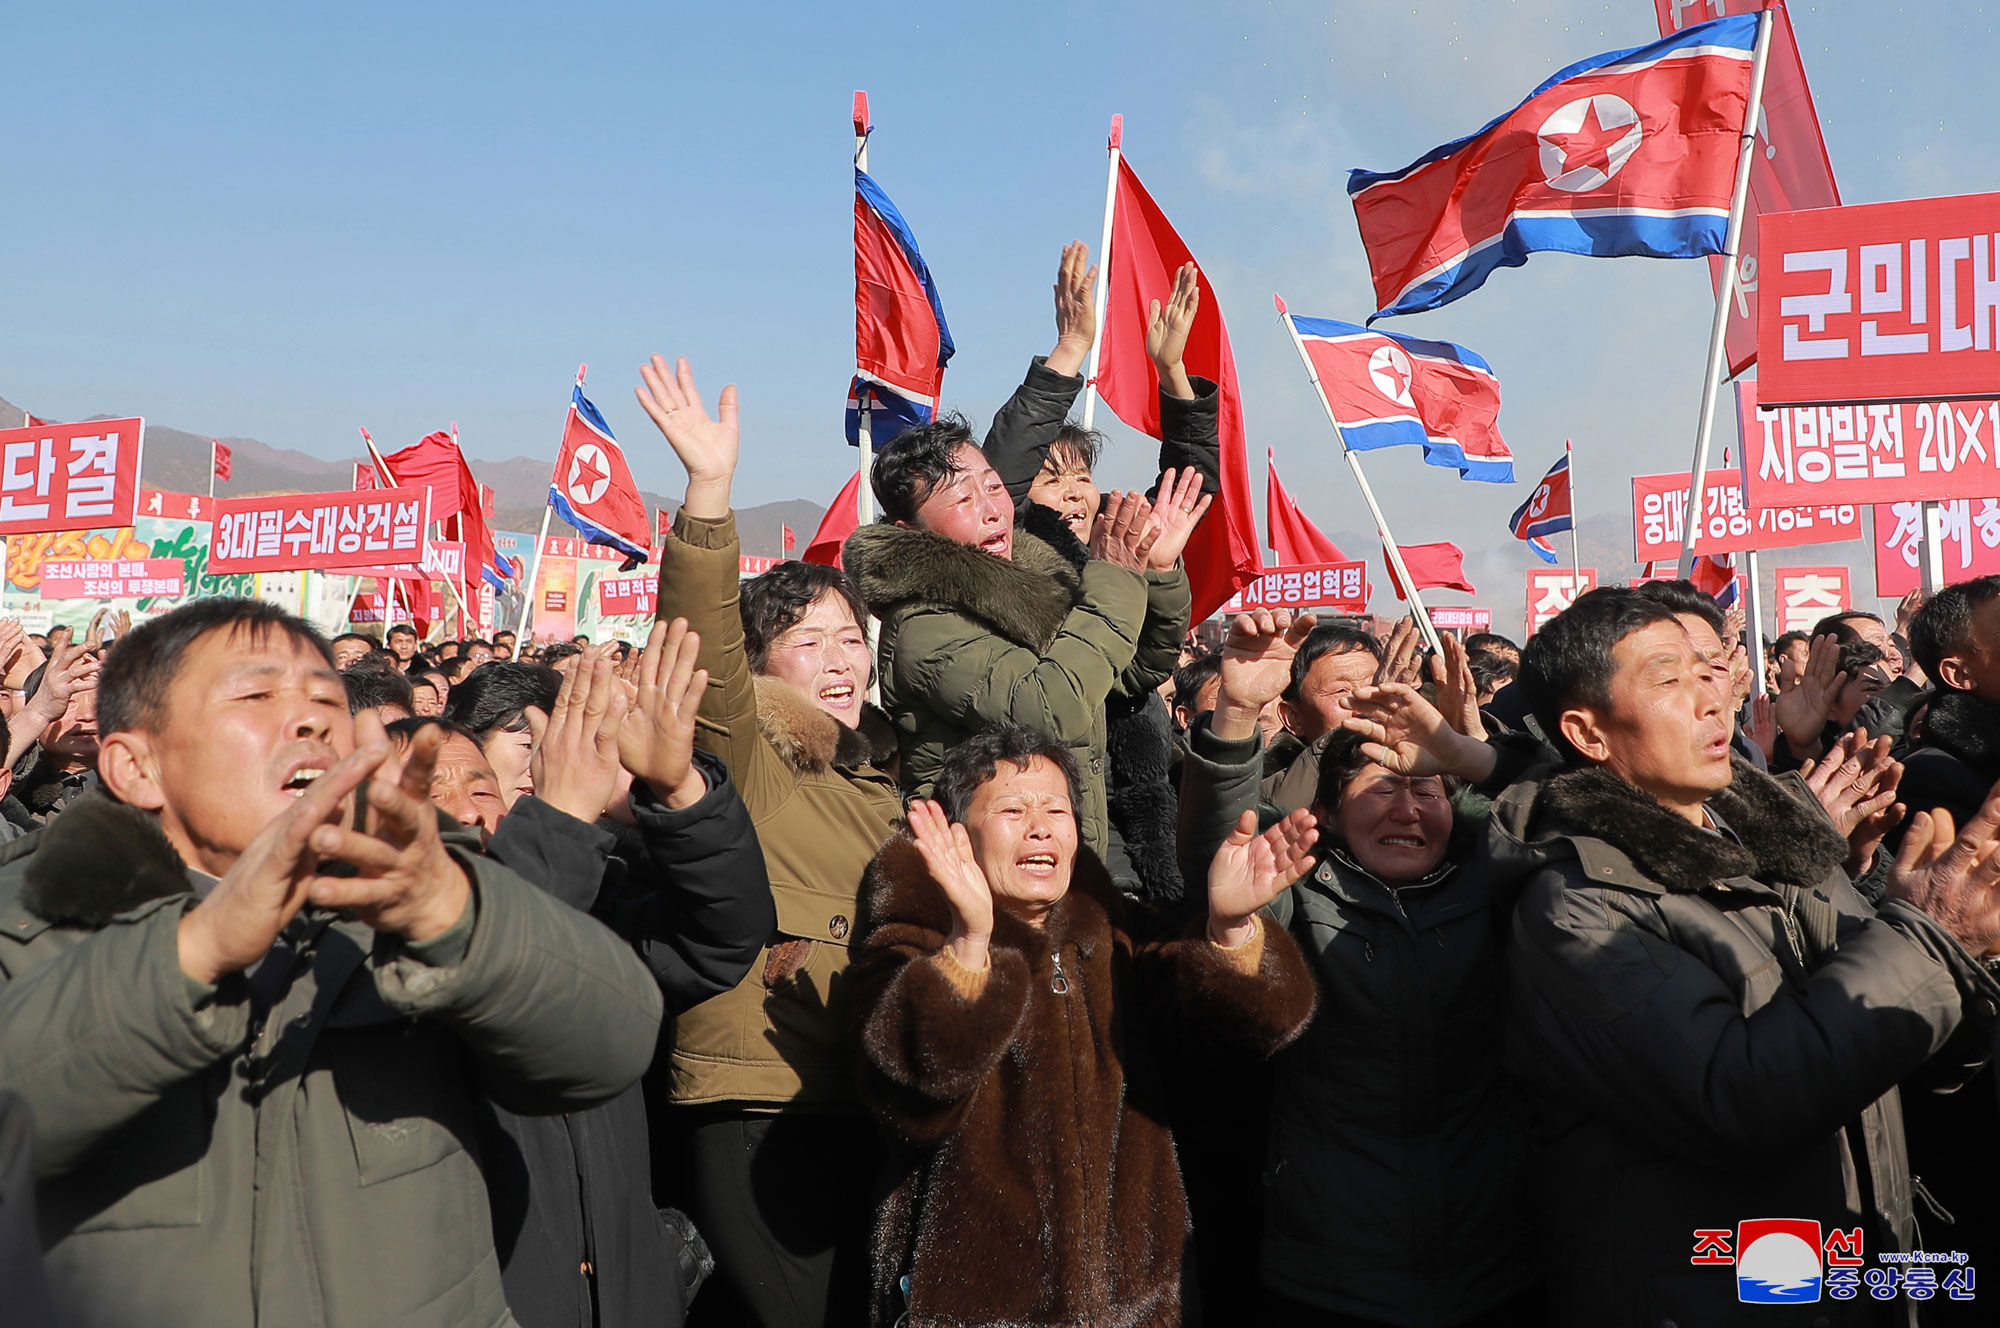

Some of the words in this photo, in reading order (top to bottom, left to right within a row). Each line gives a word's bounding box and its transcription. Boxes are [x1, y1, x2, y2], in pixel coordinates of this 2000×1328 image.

[1780, 232, 2000, 361] 군민대
[0, 432, 119, 522] 단결
[1756, 404, 1906, 484] 지방발전
[215, 501, 419, 560] 3대필수대상건설
[45, 563, 113, 579] 조선사람의
[83, 580, 123, 595] 조선의
